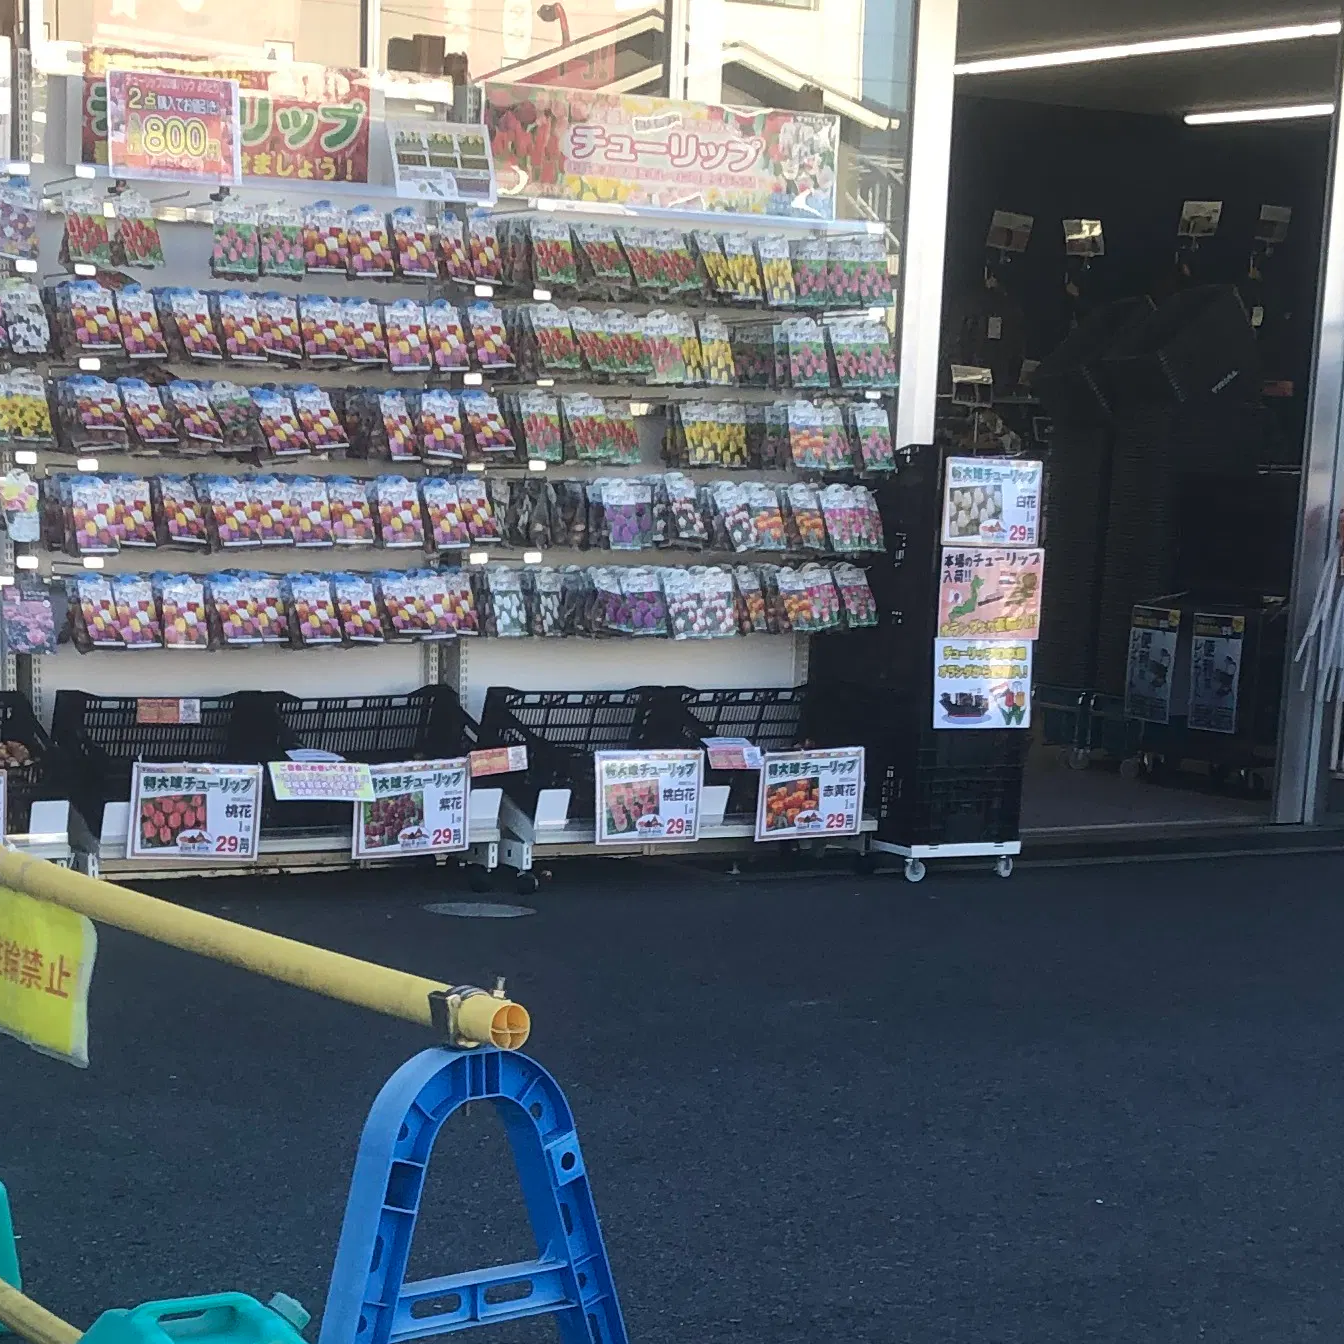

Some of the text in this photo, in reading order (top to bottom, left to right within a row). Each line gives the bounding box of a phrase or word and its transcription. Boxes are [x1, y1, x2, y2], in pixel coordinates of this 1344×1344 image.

[571, 125, 766, 172] チューリップ
[1009, 525, 1026, 541] 29
[944, 552, 1041, 568] 本場のチューリップ
[768, 759, 858, 777] 特大球チューリップ
[143, 776, 256, 793] 特大球チューリップ
[823, 783, 857, 798] 赤黄花
[662, 787, 696, 802] 桃白花
[225, 804, 253, 818] 桃花
[439, 797, 463, 812] 紫花
[666, 818, 684, 834] 29
[826, 813, 845, 828] 29
[216, 836, 238, 852] 29
[432, 828, 452, 845] 29
